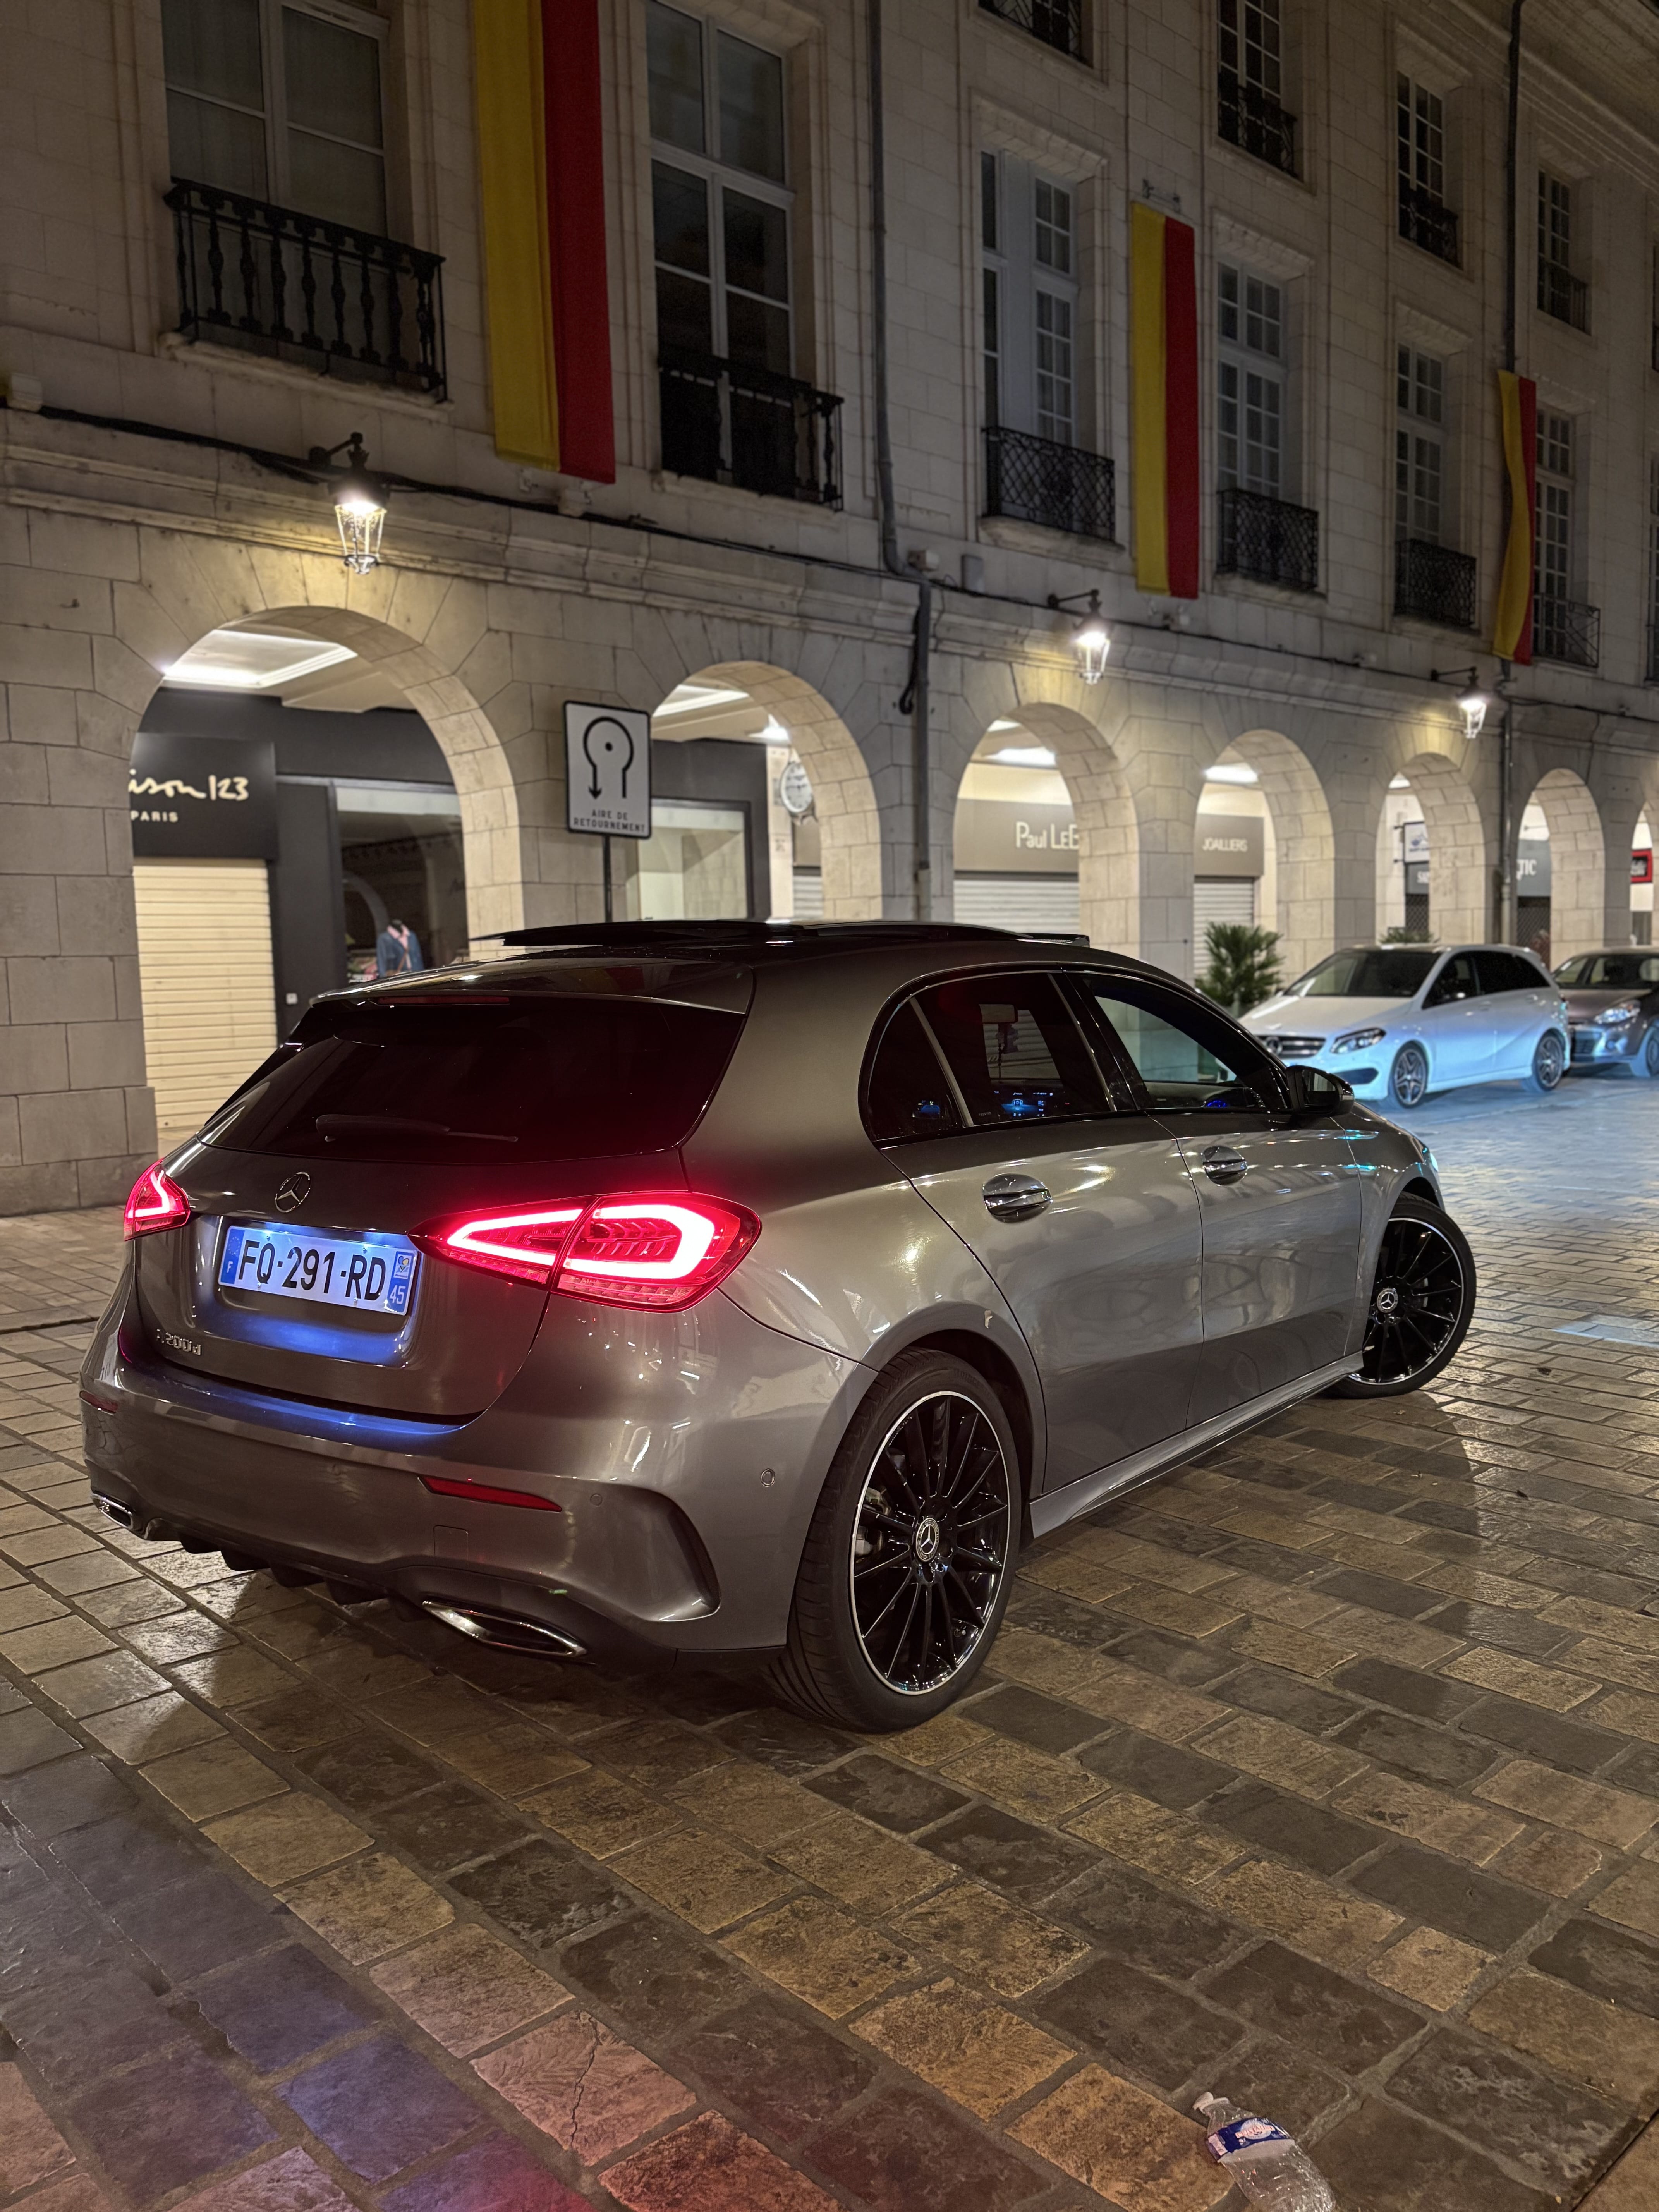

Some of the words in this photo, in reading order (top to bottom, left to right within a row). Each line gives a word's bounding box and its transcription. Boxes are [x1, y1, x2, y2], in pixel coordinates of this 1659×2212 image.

[208, 774, 249, 801] 123
[130, 810, 178, 823] PARIS
[592, 809, 611, 819] AIRE
[617, 812, 627, 820] DE
[574, 817, 645, 832] RETOURNEMENT
[1016, 821, 1047, 848] Paul
[227, 1261, 233, 1273] F
[389, 1284, 406, 1304] 45
